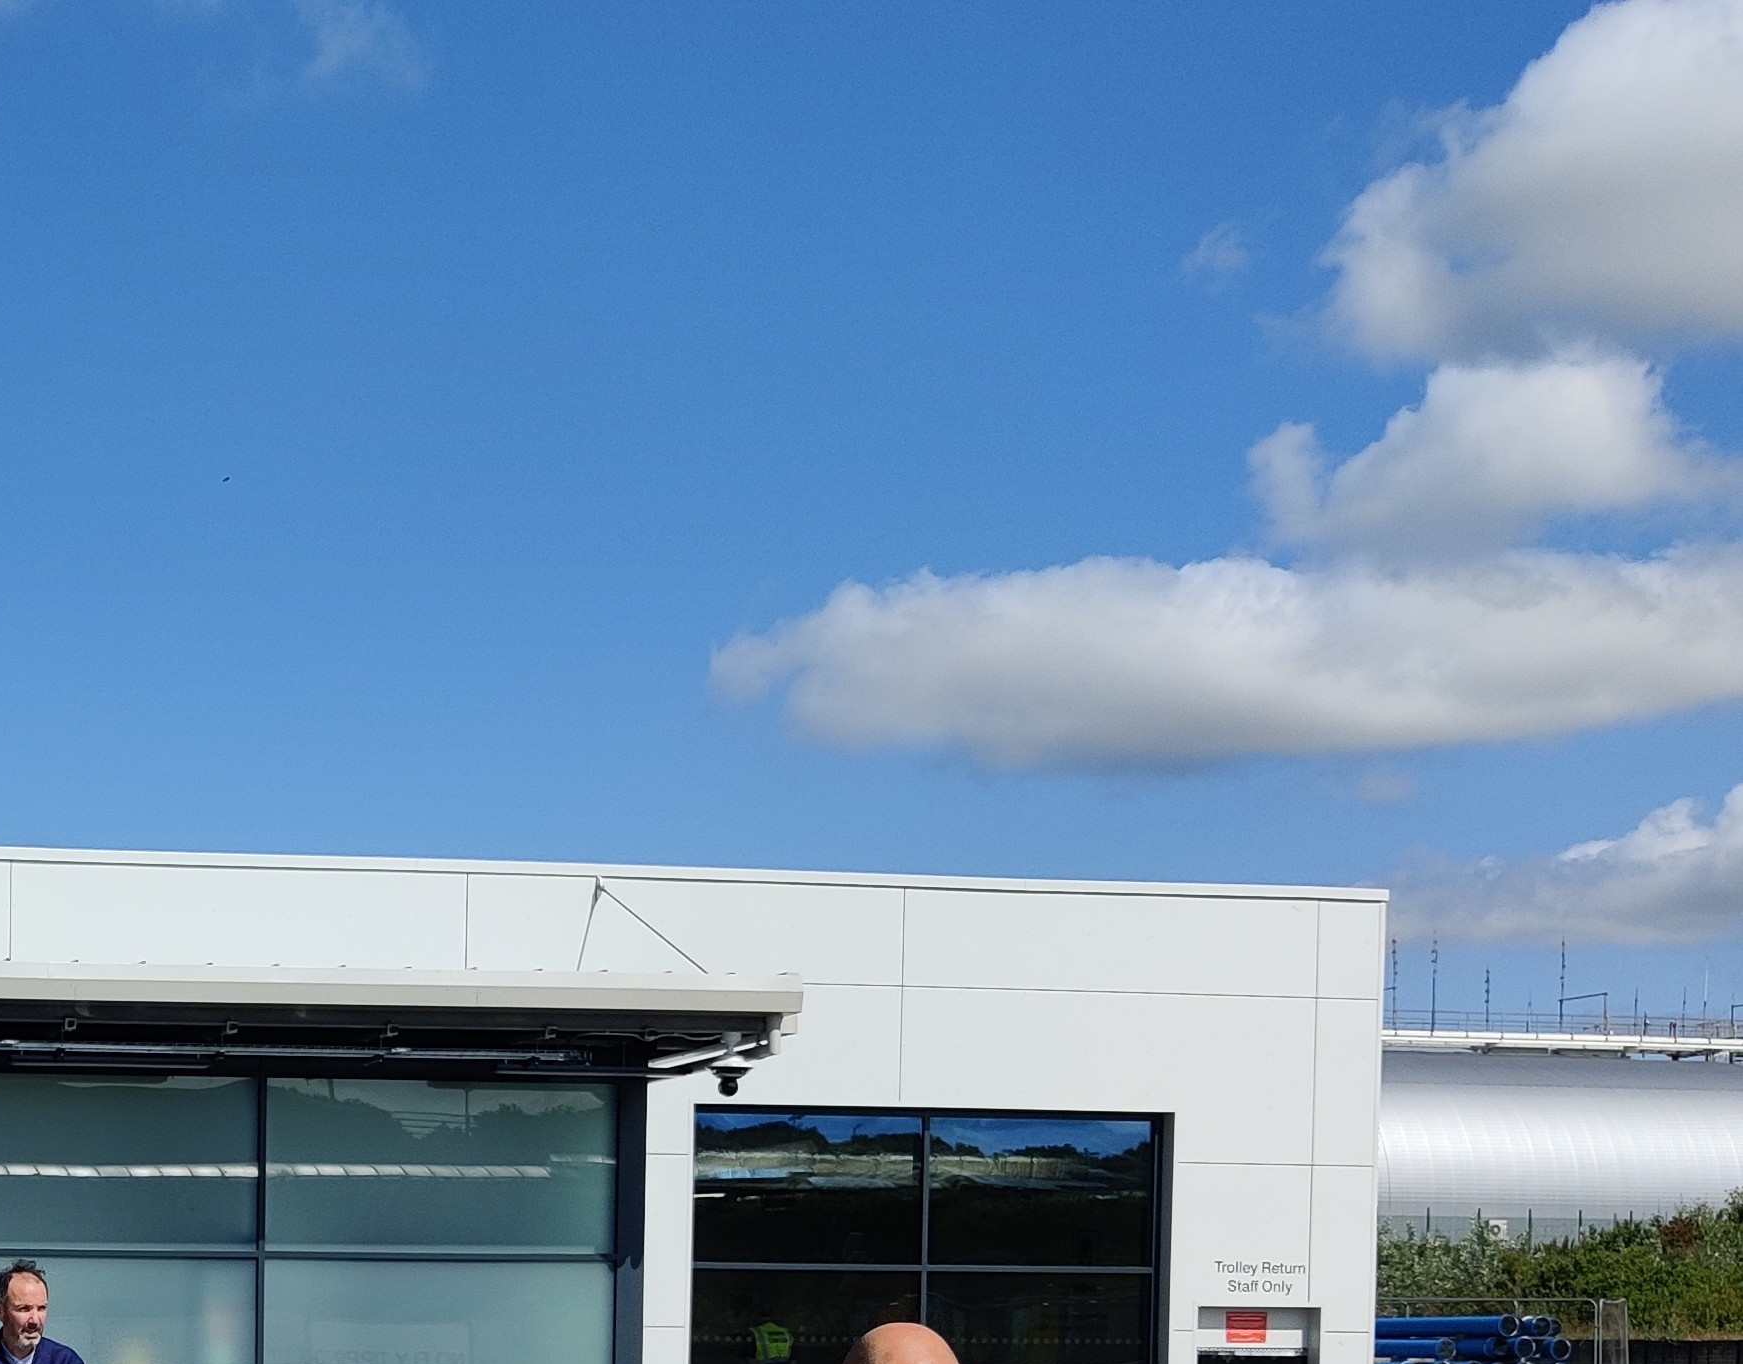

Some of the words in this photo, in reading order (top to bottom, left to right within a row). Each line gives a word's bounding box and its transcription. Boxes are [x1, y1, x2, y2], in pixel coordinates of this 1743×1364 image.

[1214, 1260, 1258, 1277] Trolley
[1261, 1261, 1306, 1275] Return
[1227, 1279, 1259, 1293] Staff
[1261, 1280, 1293, 1296] Only
